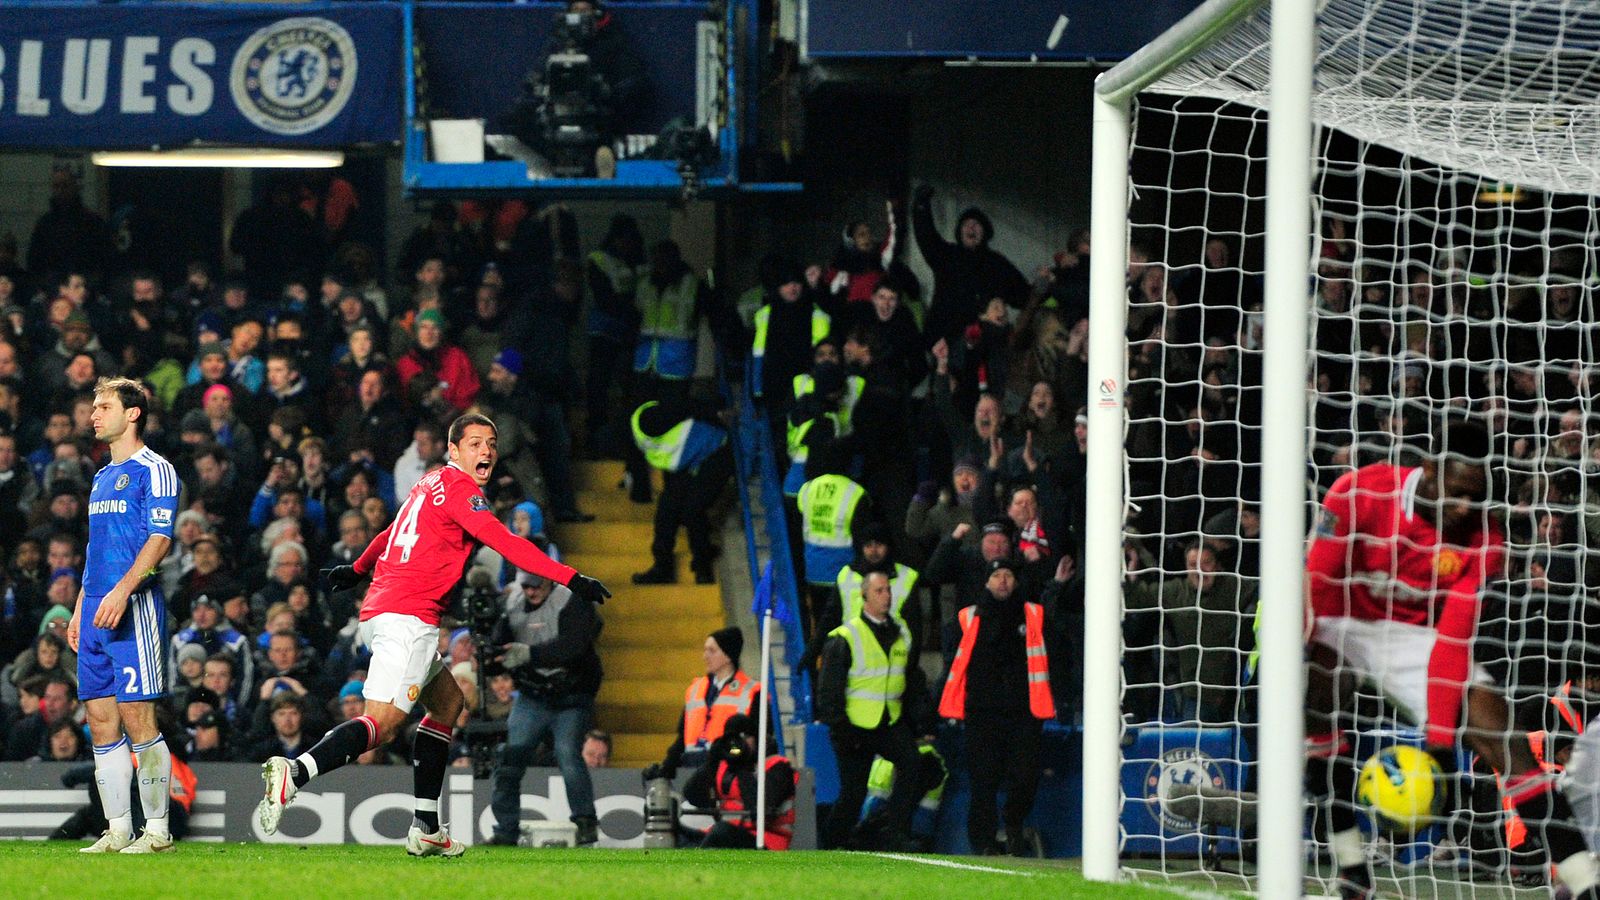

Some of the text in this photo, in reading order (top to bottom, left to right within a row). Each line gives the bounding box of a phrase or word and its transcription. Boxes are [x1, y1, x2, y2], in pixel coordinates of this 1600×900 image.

[0, 36, 216, 117] LUES
[88, 500, 127, 515] AMSUNG
[378, 492, 426, 563] 14
[122, 666, 139, 694] 2
[142, 777, 167, 785] CFC
